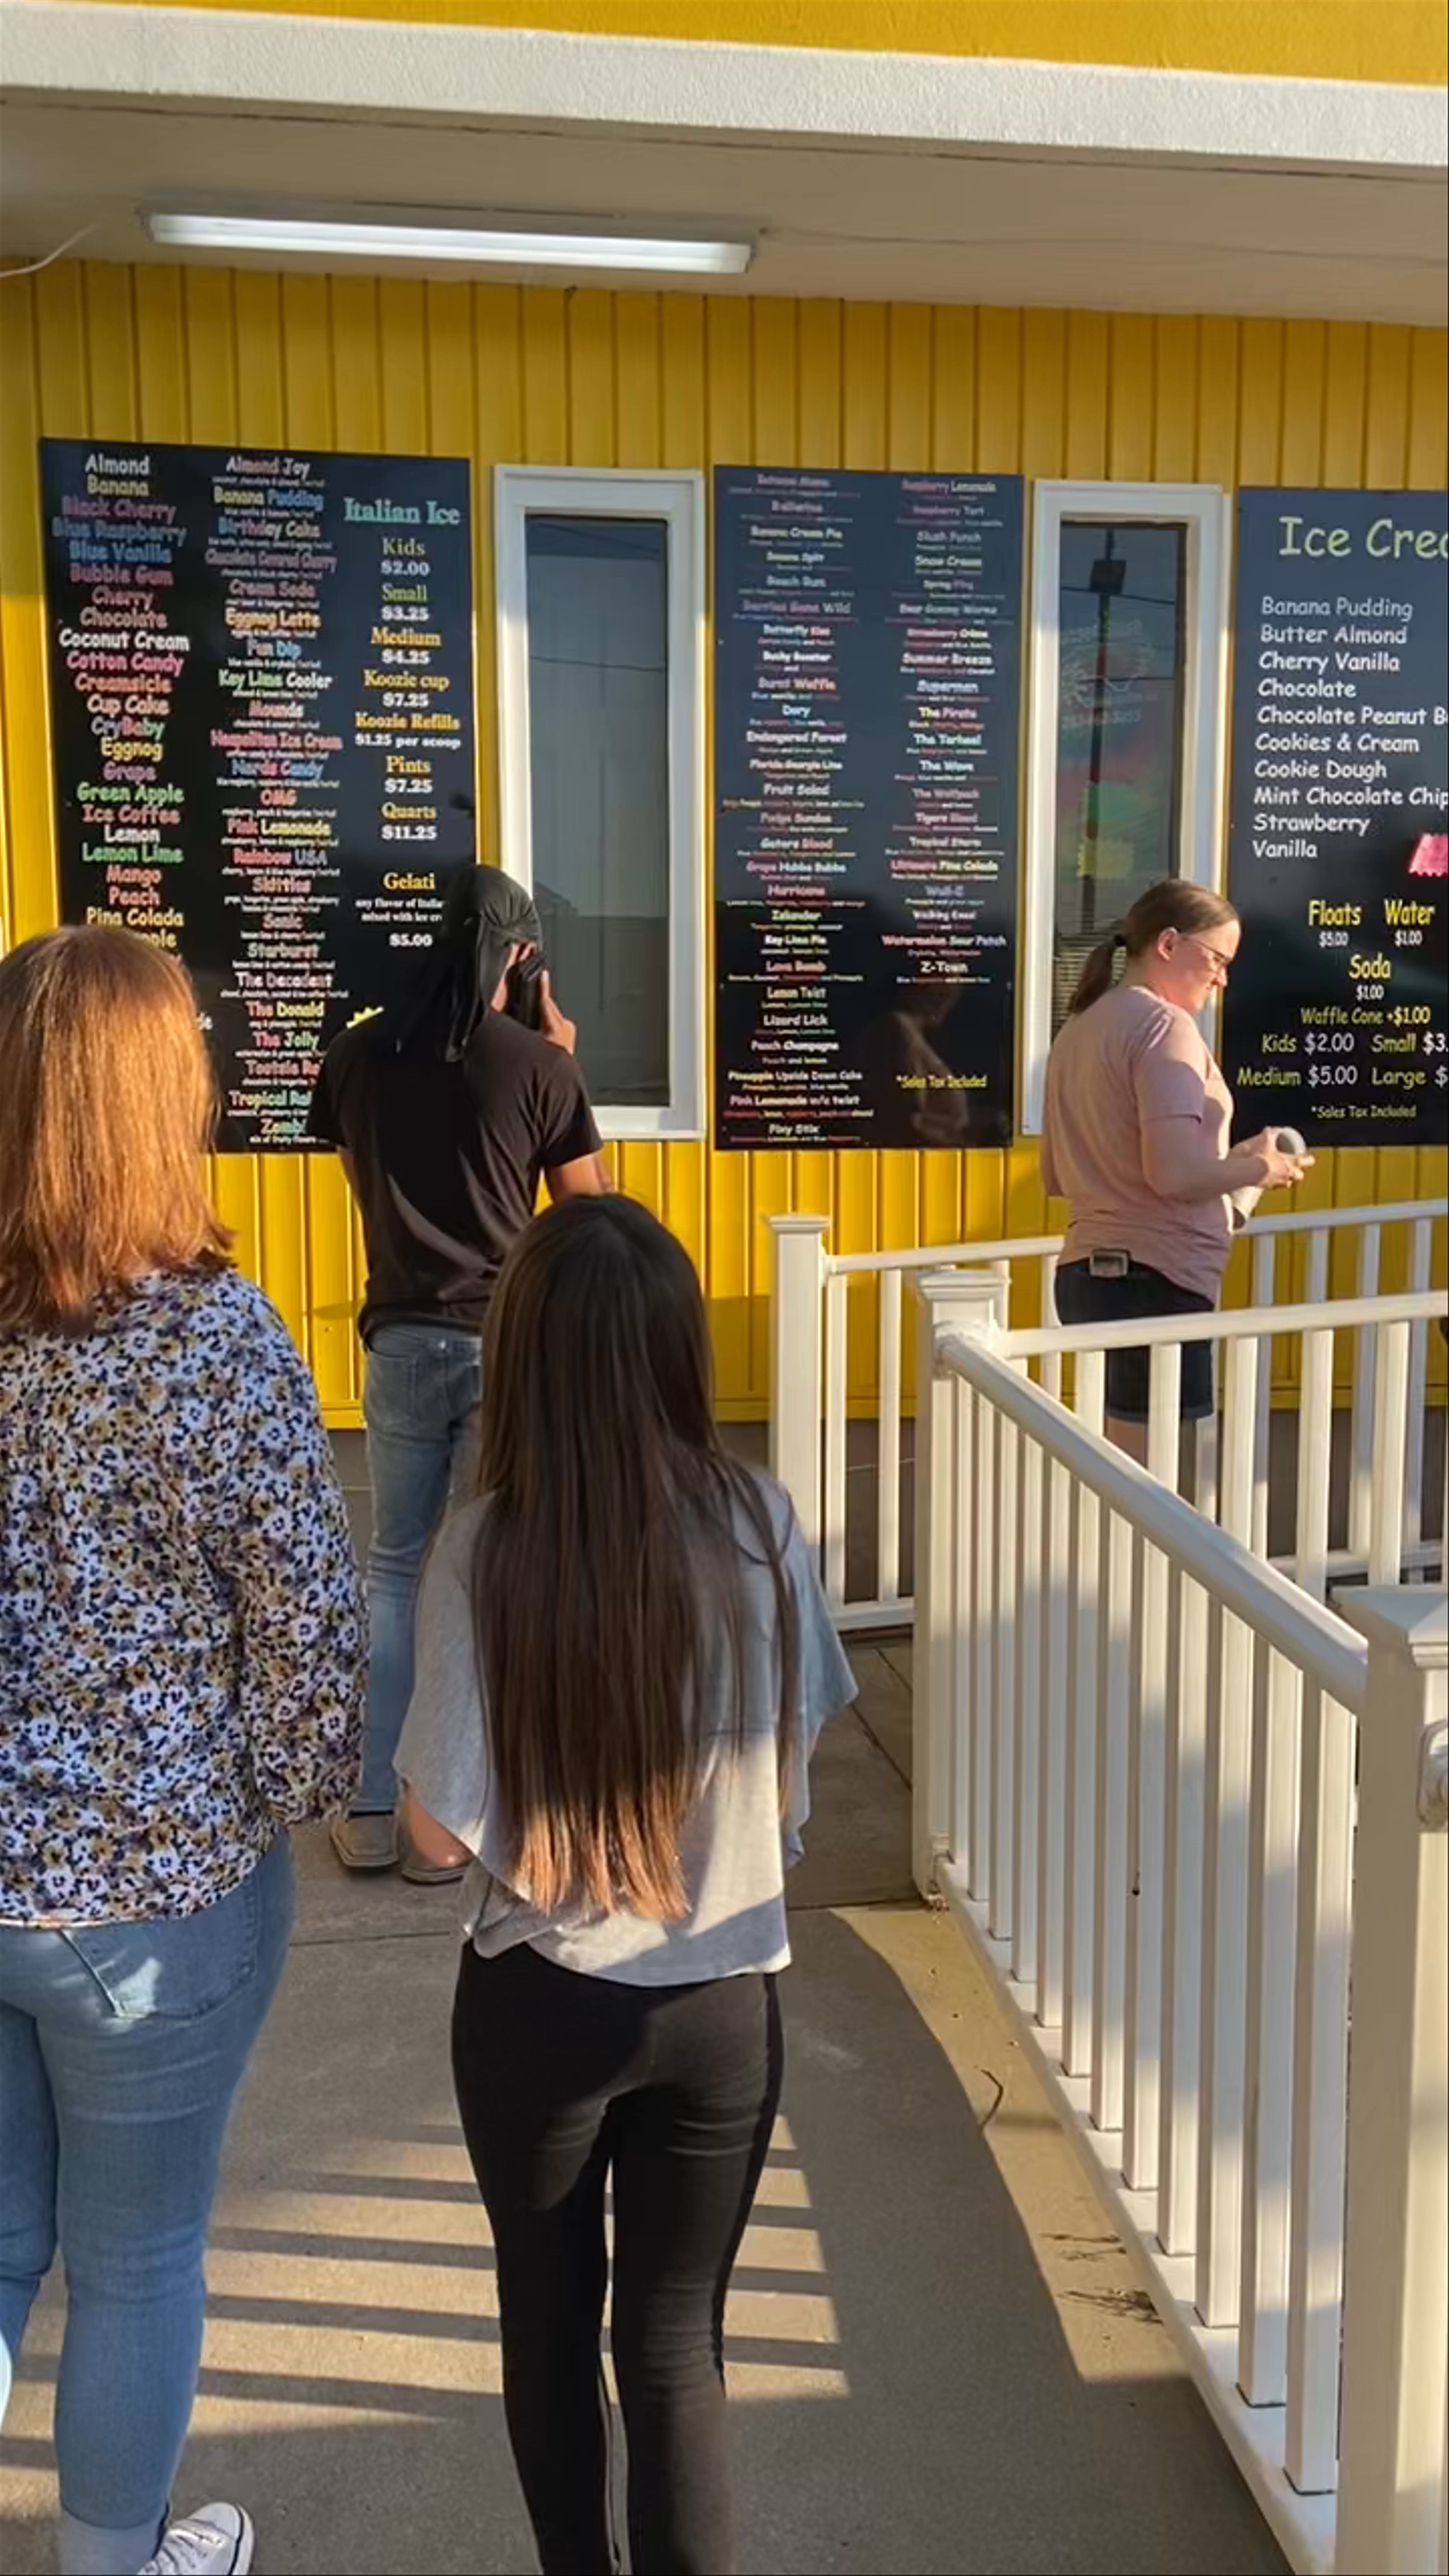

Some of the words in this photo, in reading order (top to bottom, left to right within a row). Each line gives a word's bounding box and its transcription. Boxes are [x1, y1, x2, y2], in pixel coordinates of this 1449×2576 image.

[85, 454, 149, 475] Almond
[226, 456, 280, 475] Almond
[283, 458, 310, 479] Joy
[87, 475, 149, 496] Banana
[214, 486, 264, 505] Banana
[268, 491, 324, 511] Pudding
[62, 497, 110, 516] Black
[114, 500, 176, 524] Cherry
[344, 497, 419, 524] Italian
[426, 500, 460, 525] Ice
[52, 517, 91, 537] Blue
[95, 521, 186, 546] Raspberry
[218, 518, 281, 539] Birthday
[285, 521, 320, 538] Cake
[1279, 516, 1352, 557] Ice
[1366, 518, 1447, 559] Cre
[69, 541, 108, 560] Blue
[112, 543, 172, 564] Vanilla
[383, 538, 425, 556] Kids
[70, 564, 130, 583] Bubble
[135, 566, 173, 585] Gum
[381, 560, 430, 577] $2.00
[91, 586, 153, 610] Cherry
[229, 579, 275, 597] Cream
[279, 582, 315, 598] Soda
[381, 584, 427, 603] Small
[80, 607, 168, 629] Chocolate
[225, 608, 277, 629] Eggnog
[381, 606, 429, 621] $3.25
[1262, 596, 1330, 616] Banana
[1336, 597, 1413, 621] Pudding
[59, 629, 129, 649] Coconut
[134, 631, 190, 651] Cream
[370, 627, 441, 646] Medium
[1261, 623, 1327, 644] Butter
[1334, 626, 1407, 644] Almond
[246, 640, 274, 657] Fun
[276, 641, 301, 660] Dip
[381, 650, 430, 664] $4.25
[66, 651, 127, 670] Cotton
[131, 654, 184, 677] Candy
[1259, 651, 1328, 676] Cherry
[1335, 652, 1400, 672] Vanilla
[75, 673, 172, 693] Creamsicle
[219, 670, 246, 691] Key
[248, 671, 283, 687] Lime
[286, 672, 332, 689] Cooler
[364, 669, 417, 688] Koozie
[420, 674, 449, 691] cup
[917, 680, 978, 694] Superman
[1258, 678, 1357, 698] Chocolate
[87, 695, 121, 717] Cup
[125, 696, 169, 715] Cake
[249, 700, 303, 717] Mounds
[383, 692, 429, 707] $7.25
[782, 704, 810, 717] Dory
[918, 707, 940, 718] The
[1257, 705, 1355, 725] Chocolate
[1361, 707, 1426, 725] Peanut
[91, 717, 165, 740] CryBaby
[355, 712, 407, 729] Koozie
[411, 713, 460, 731] Refills
[101, 738, 162, 761] Eggnog
[355, 734, 392, 746] $1.25
[395, 736, 419, 749] per
[421, 738, 461, 750] scoop
[1255, 733, 1331, 752] Cookies
[1337, 734, 1351, 752] &
[1357, 734, 1420, 753] Cream
[103, 762, 156, 785] Grape
[232, 760, 277, 775] Nerds
[281, 761, 324, 780] Candy
[385, 755, 431, 773] Pints
[920, 760, 941, 770] The
[1254, 760, 1319, 779] Cookie
[1326, 760, 1387, 783] Dough
[77, 782, 130, 802] Green
[134, 784, 185, 808] Apple
[385, 779, 432, 794] $7.25
[260, 789, 297, 806] OMG
[1254, 786, 1299, 805] Mint
[1306, 786, 1403, 806] Chocolate
[1409, 787, 1447, 810] Chip
[82, 804, 114, 823] Ice
[118, 806, 180, 824] Coffee
[381, 802, 437, 820] Quarts
[104, 825, 160, 843] Lemon
[227, 818, 258, 834] Pink
[261, 820, 331, 836] Lemonade
[381, 825, 437, 841] $11.25
[1254, 814, 1371, 836] Strawberry
[82, 843, 138, 862] Lemon
[142, 845, 183, 863] Lime
[233, 848, 291, 865] Rainbow
[294, 850, 328, 866] USA
[1253, 840, 1317, 858] Vanilla
[106, 865, 162, 886] Mango
[384, 872, 435, 890] Gelati
[109, 886, 160, 906] Peach
[355, 899, 372, 910] any
[375, 898, 404, 909] flavor
[406, 898, 417, 909] of
[417, 898, 443, 909] Italia
[127, 908, 185, 926] Colada
[263, 914, 302, 928] Sonic
[361, 912, 390, 922] mixed
[392, 912, 414, 922] with
[1309, 900, 1361, 927] Floats
[1384, 899, 1435, 926] Water
[389, 934, 432, 947] $5.00
[765, 935, 783, 947] Key
[811, 935, 827, 945] Pie
[1319, 932, 1349, 947] $5.00
[1395, 930, 1423, 947] $1.00
[248, 943, 319, 958] Starburst
[1349, 953, 1391, 980] Soda
[235, 972, 263, 987] The
[1357, 985, 1384, 1001] $1.00
[246, 1001, 273, 1016] The
[276, 1002, 324, 1017] Donald
[1301, 1007, 1348, 1025] Waffle
[1351, 1008, 1383, 1025] Cone
[804, 1015, 828, 1026] Lick
[253, 1032, 280, 1047] The
[284, 1032, 319, 1050] Jolly
[784, 1040, 839, 1052] Champagne
[1262, 1034, 1297, 1053] Kids
[1304, 1032, 1354, 1054] $2.00
[1371, 1034, 1416, 1053] Small
[1423, 1032, 1448, 1054] $3.
[1237, 1067, 1301, 1086] Medium
[1308, 1065, 1357, 1087] $5.00
[1372, 1067, 1426, 1090] Large
[1349, 1106, 1368, 1118] Tax
[1371, 1106, 1417, 1118] Included
